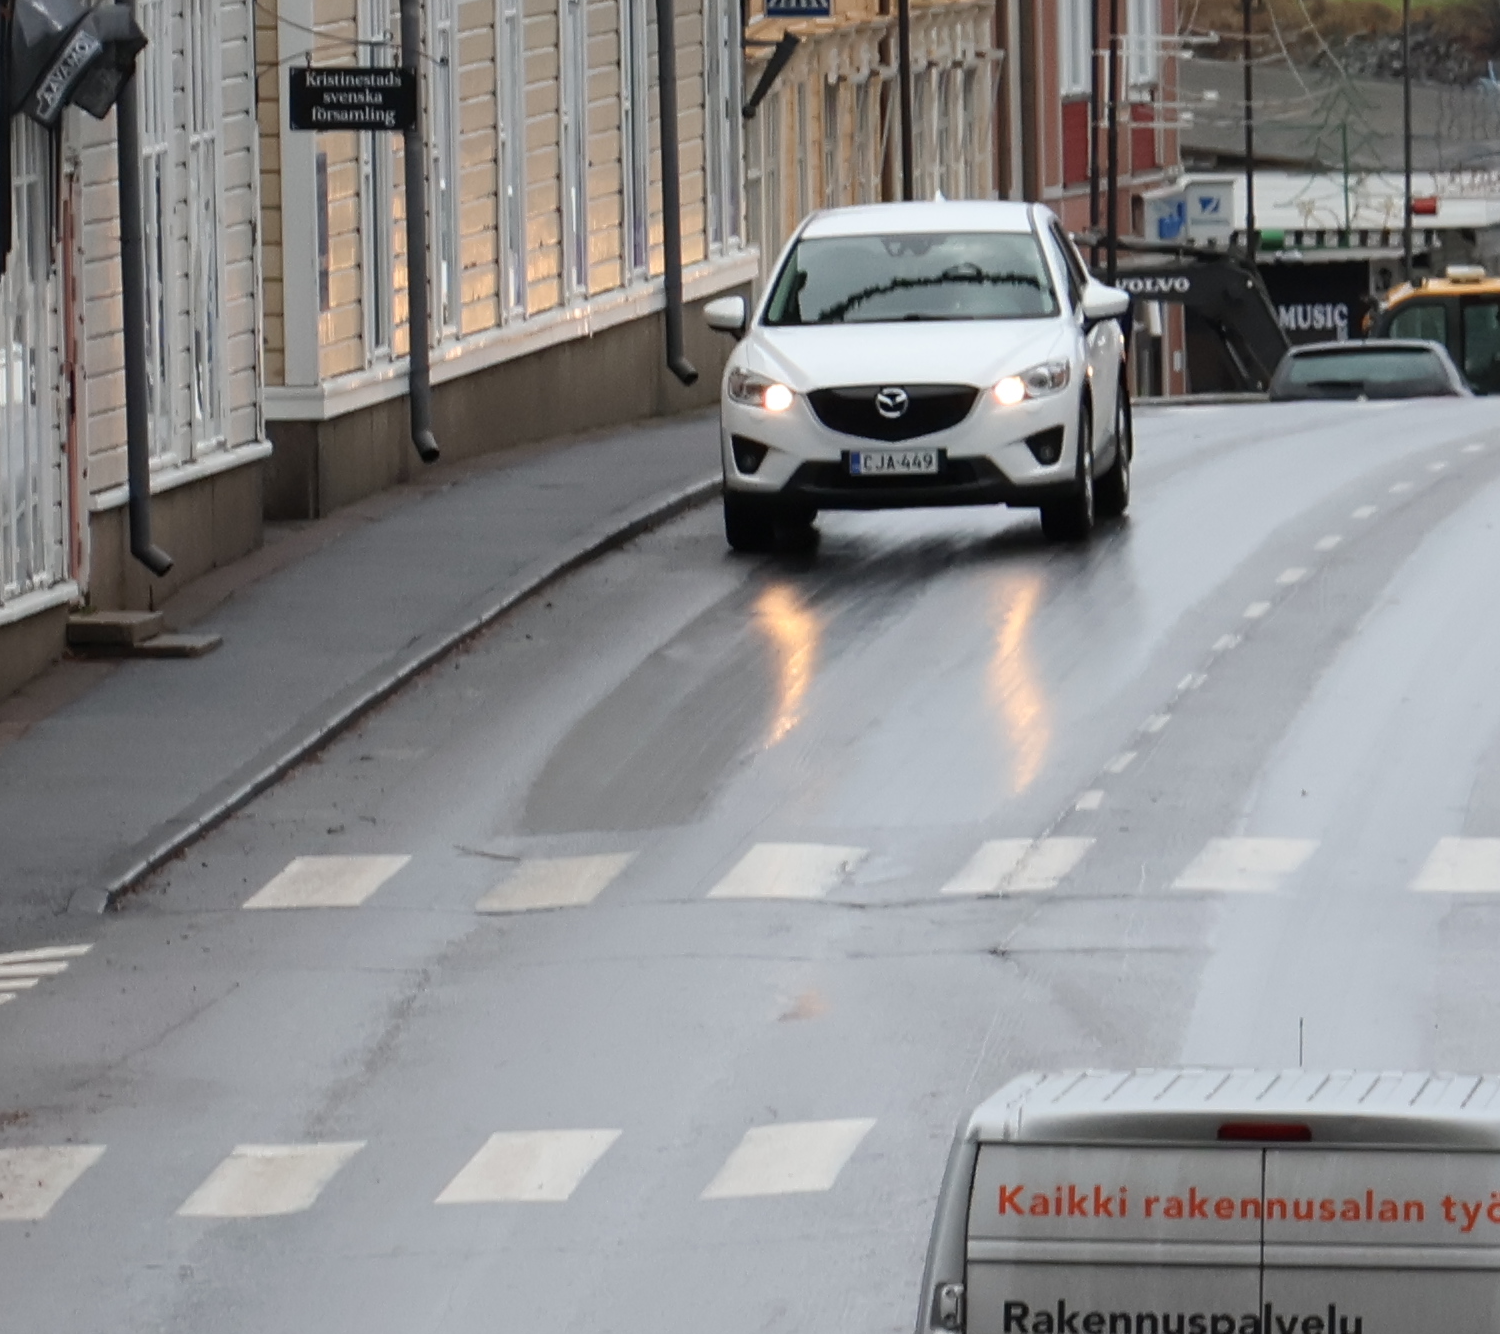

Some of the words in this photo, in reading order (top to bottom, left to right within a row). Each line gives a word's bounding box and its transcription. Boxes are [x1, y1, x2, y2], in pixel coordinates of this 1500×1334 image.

[305, 70, 402, 87] Kristinestads
[322, 87, 383, 104] svenska
[311, 105, 396, 127] församling
[1115, 276, 1191, 293] VOLVO
[1277, 302, 1349, 331] MUSIC
[863, 452, 934, 472] CJA-449
[999, 1184, 1129, 1219] Kaikki
[1143, 1187, 1425, 1223] rakennusalan
